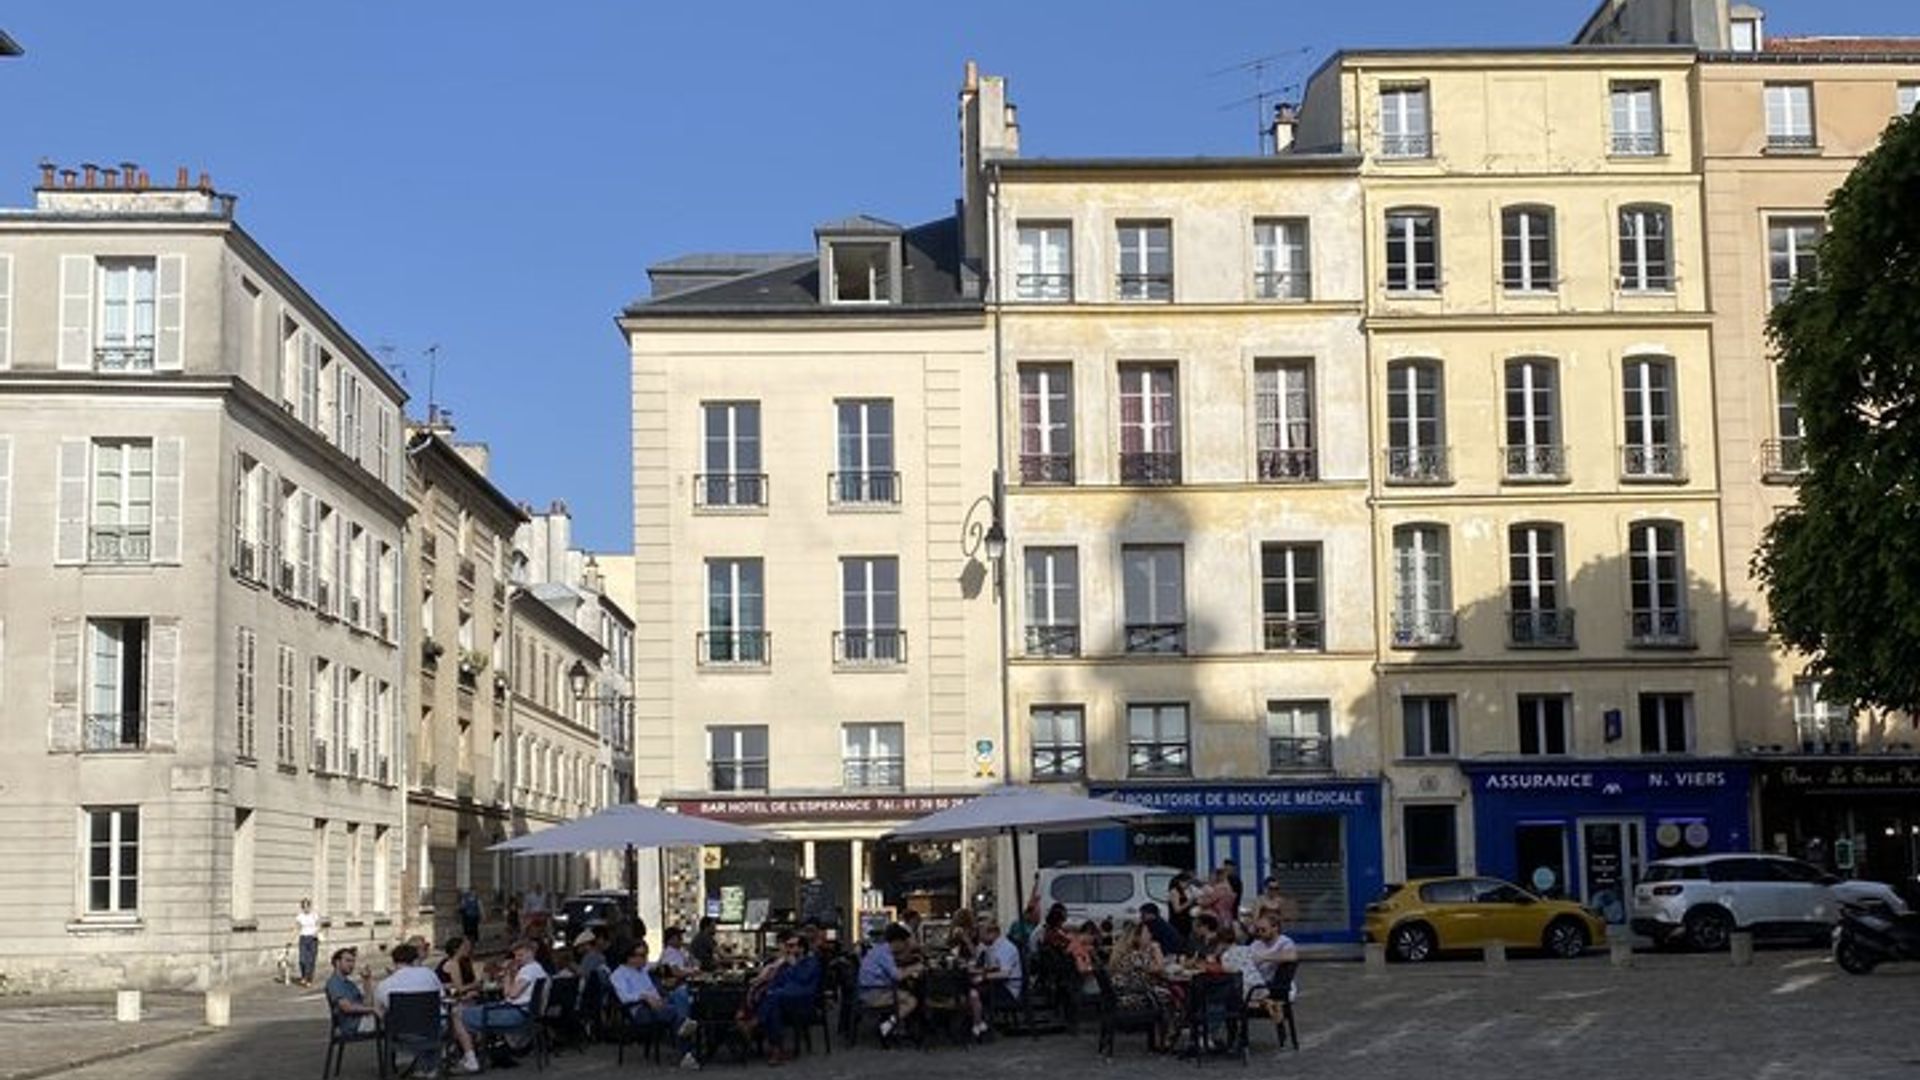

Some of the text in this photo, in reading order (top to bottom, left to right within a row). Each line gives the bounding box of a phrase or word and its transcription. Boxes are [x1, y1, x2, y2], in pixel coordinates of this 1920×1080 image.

[1486, 774, 1593, 788] ASSURANCE
[1649, 773, 1669, 787] N.
[1675, 772, 1726, 786] VIERS
[1205, 793, 1224, 806] DE
[1227, 792, 1291, 806] BIOLOGIE
[1295, 789, 1364, 805] MÉDICALE
[701, 801, 726, 813] BAR
[728, 801, 769, 813] HOTEL
[770, 801, 788, 812] DE
